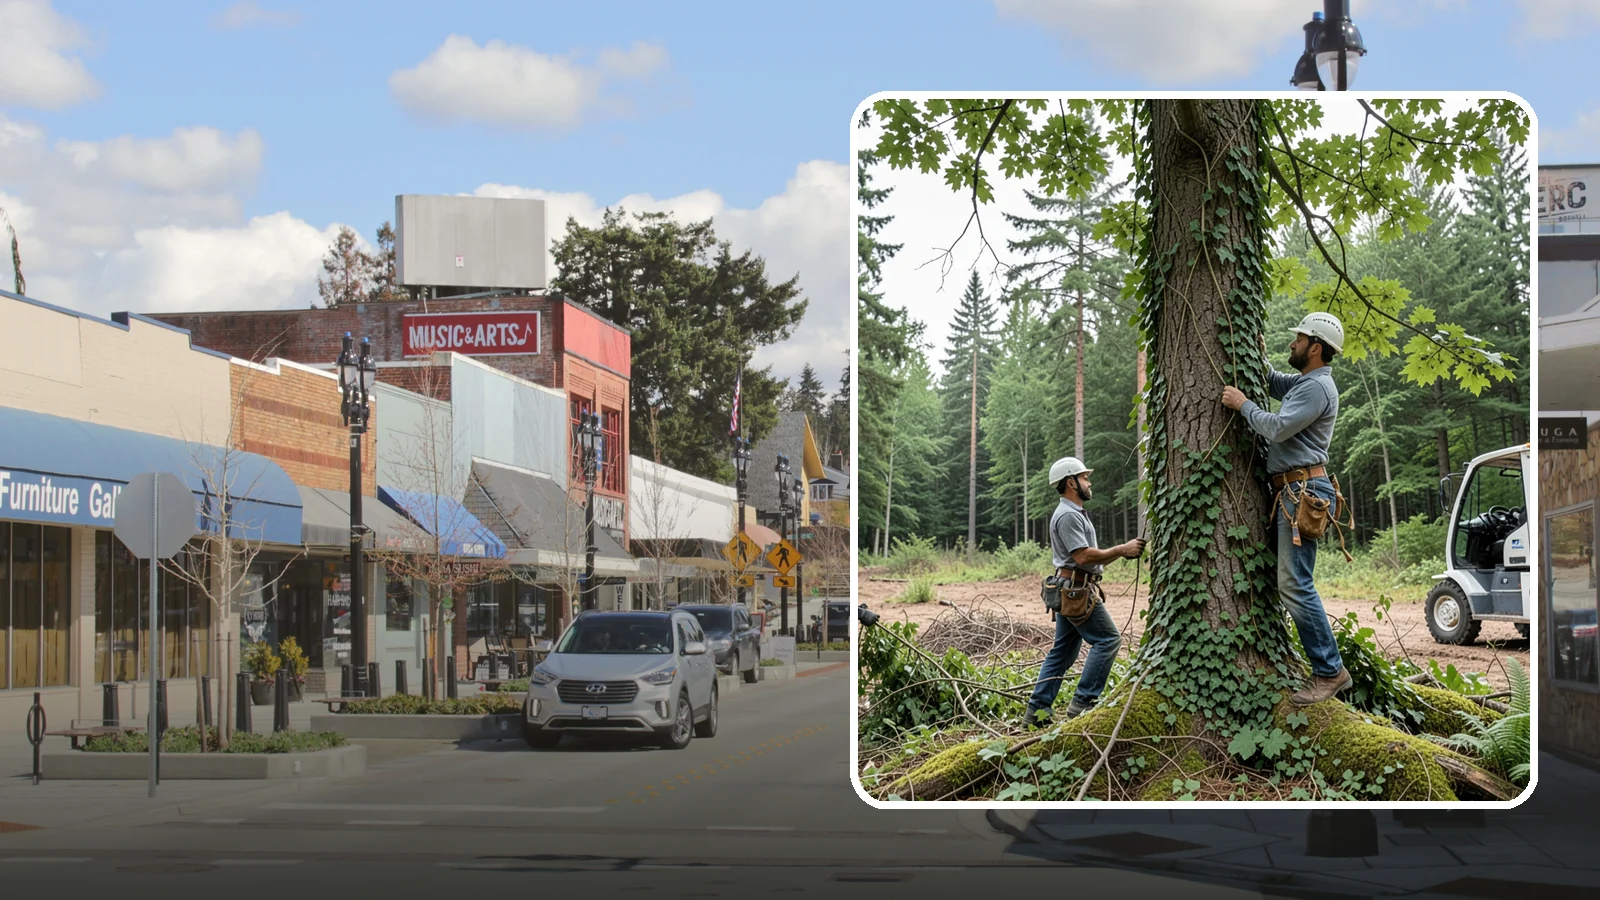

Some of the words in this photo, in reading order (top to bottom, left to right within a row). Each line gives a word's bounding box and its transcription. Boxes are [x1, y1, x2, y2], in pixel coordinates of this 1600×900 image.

[1540, 427, 1577, 436] UGA
[0, 471, 79, 515] Furniture
[453, 563, 479, 574] SUSHI
